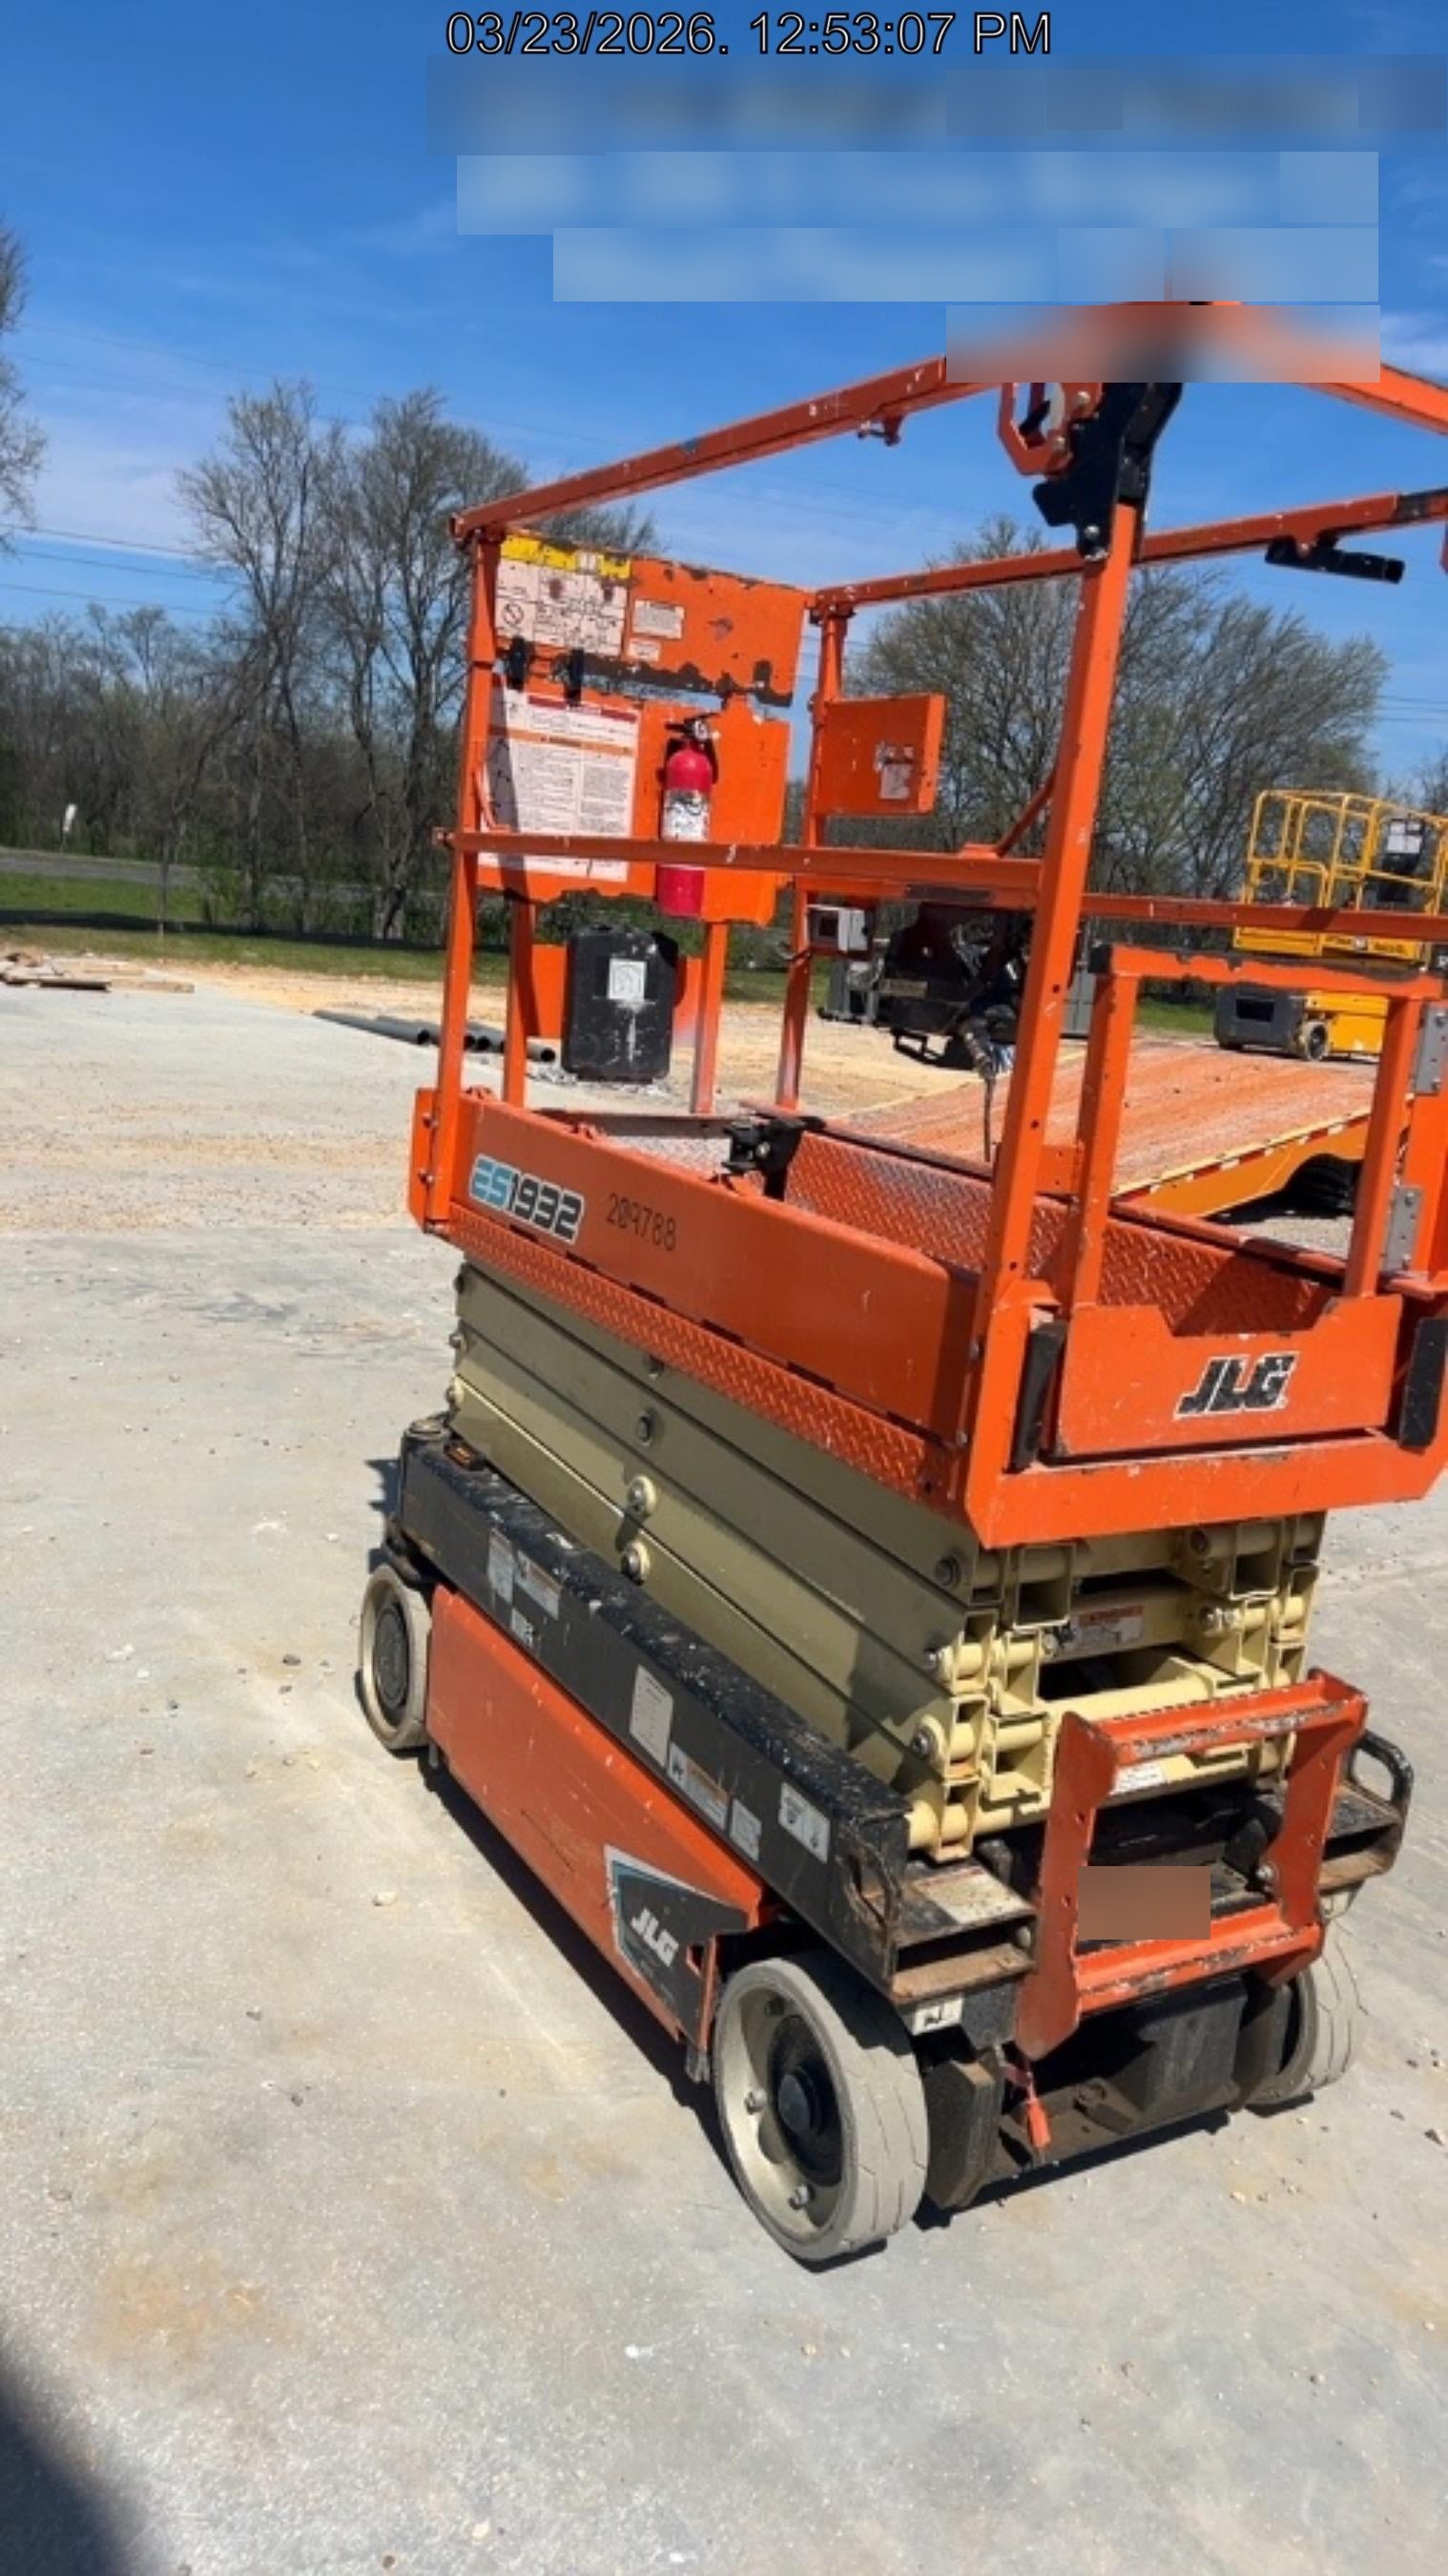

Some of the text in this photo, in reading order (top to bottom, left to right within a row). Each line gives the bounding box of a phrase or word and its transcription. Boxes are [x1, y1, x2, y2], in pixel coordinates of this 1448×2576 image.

[469, 1153, 584, 1243] ES1932
[1175, 1352, 1298, 1418] JLG
[631, 1907, 679, 1967] JLG
